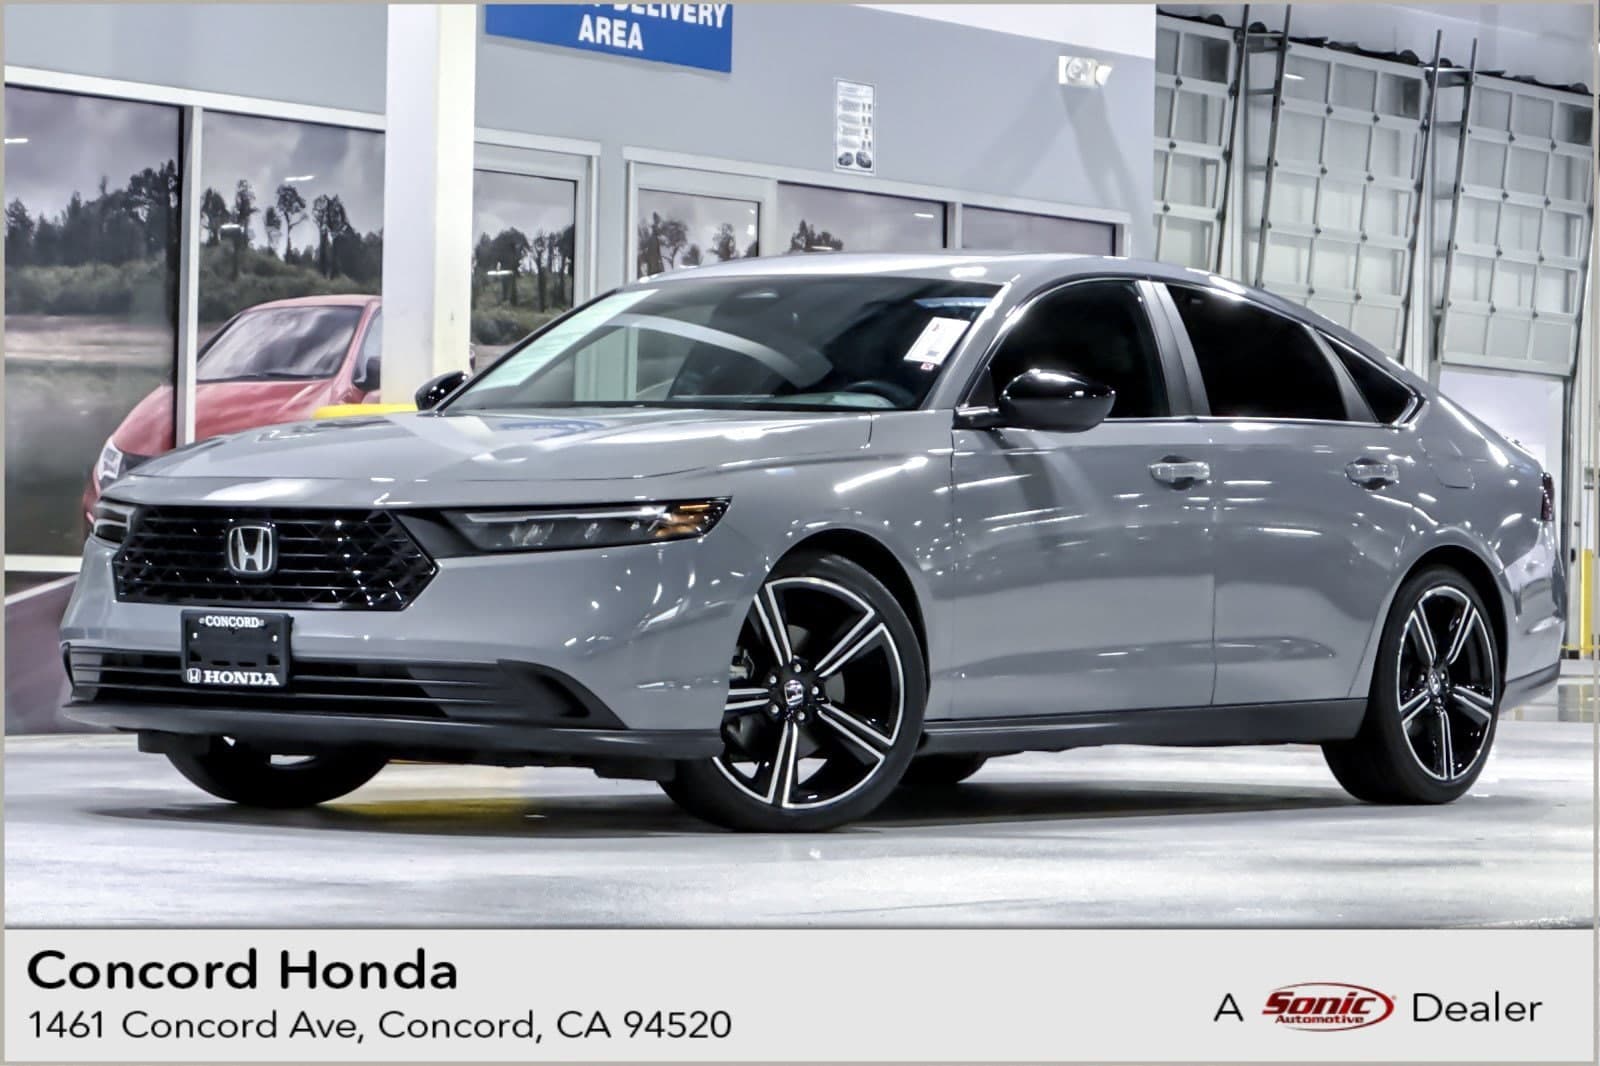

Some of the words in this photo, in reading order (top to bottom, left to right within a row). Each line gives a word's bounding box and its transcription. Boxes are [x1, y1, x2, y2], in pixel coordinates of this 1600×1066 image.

[613, 4, 728, 28] LIVERY
[578, 14, 644, 51] AREA
[205, 615, 260, 629] CONCORD
[203, 670, 280, 687] HONDA
